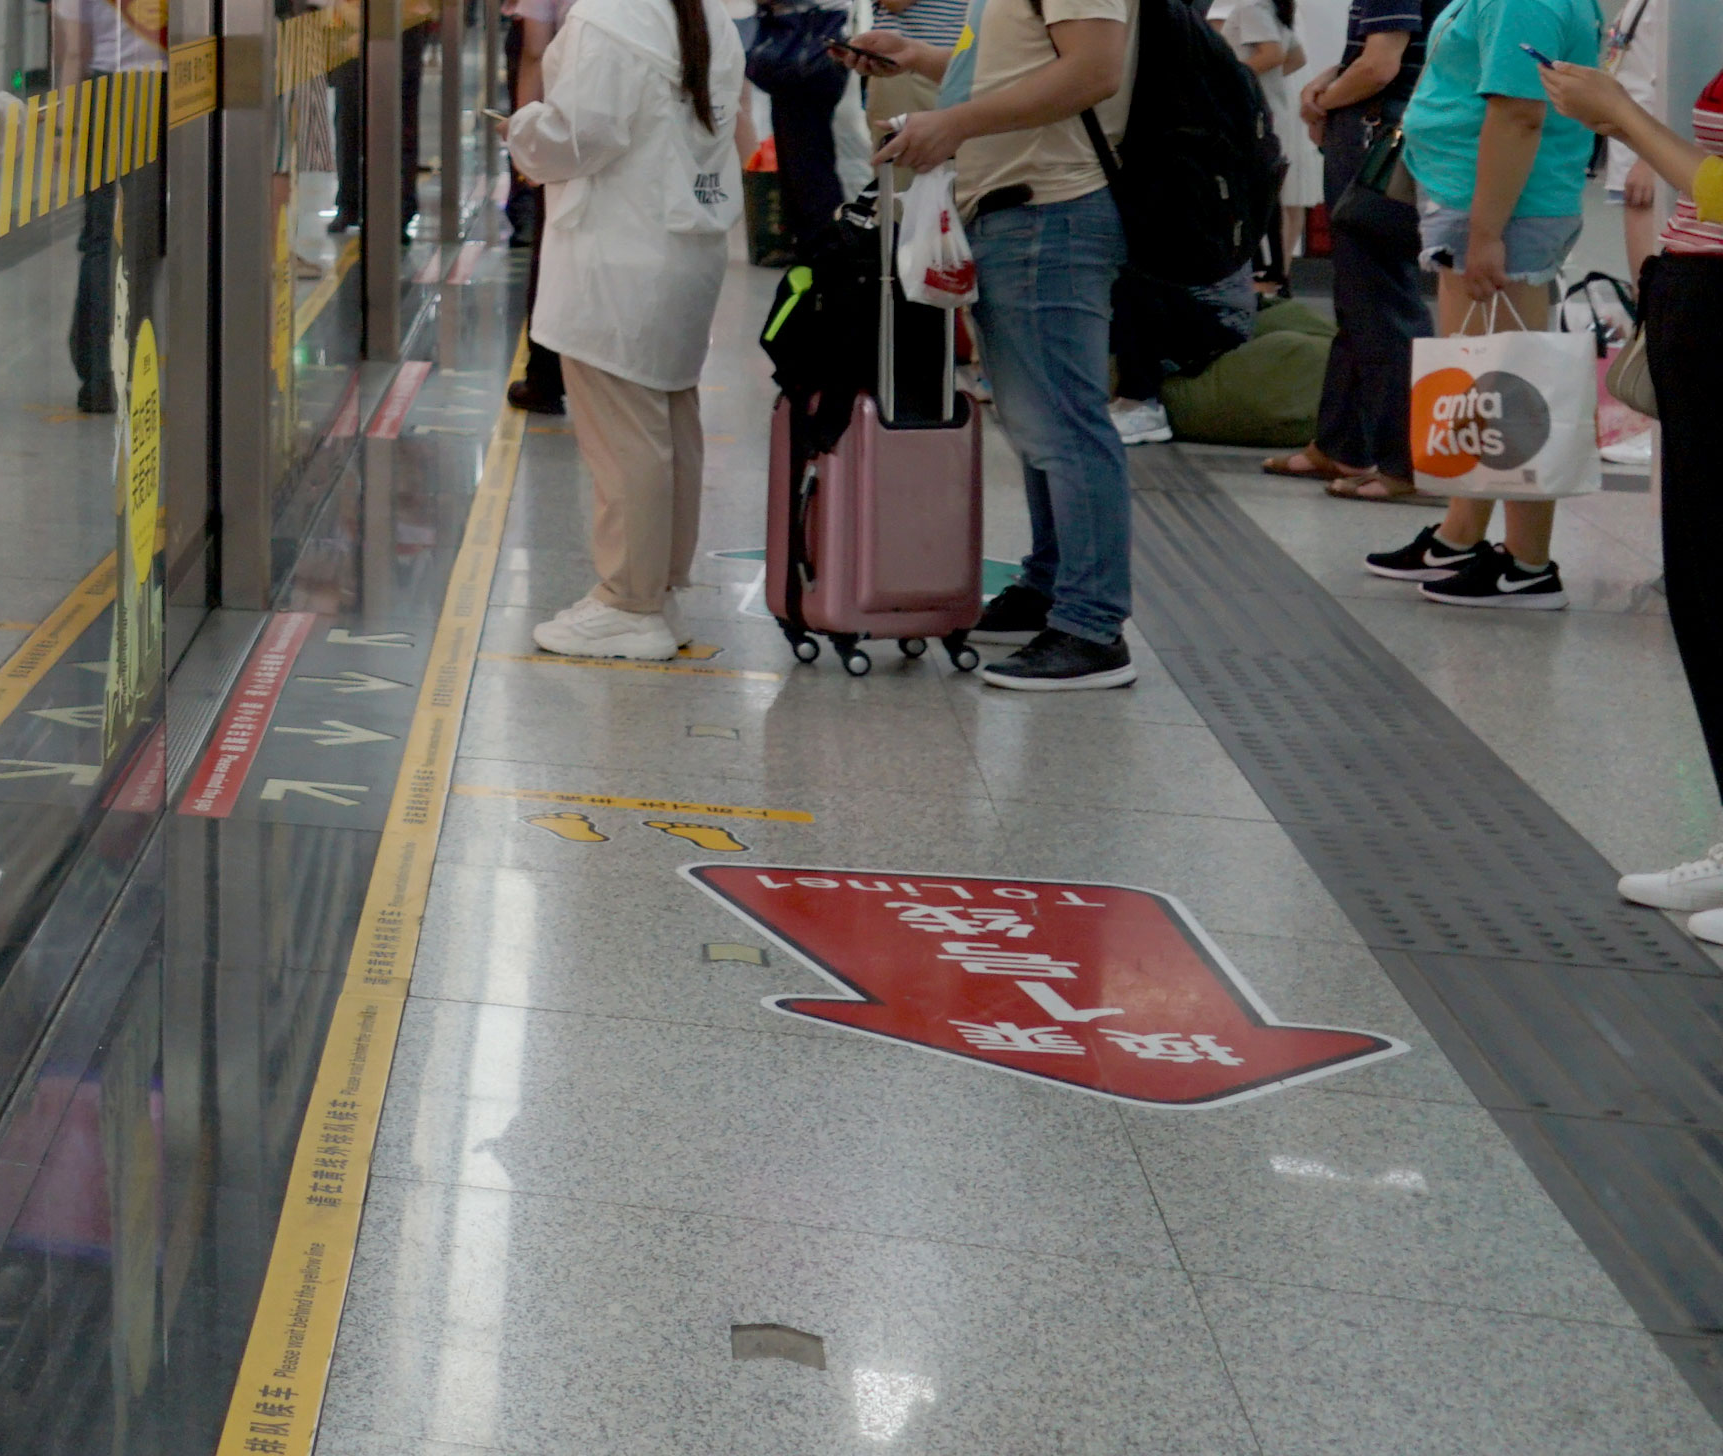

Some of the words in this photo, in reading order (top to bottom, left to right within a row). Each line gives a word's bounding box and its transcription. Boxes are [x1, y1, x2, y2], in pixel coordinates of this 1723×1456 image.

[1432, 390, 1503, 421] anta
[1425, 425, 1506, 458] kids
[947, 1018, 1246, 1067] 换乘
[305, 1103, 361, 1206] 请在黄线外排队候车
[302, 1242, 324, 1257] line
[299, 1255, 321, 1284] yellow
[286, 1297, 313, 1329] behind
[284, 1329, 306, 1349] wait
[273, 1349, 300, 1379] Please
